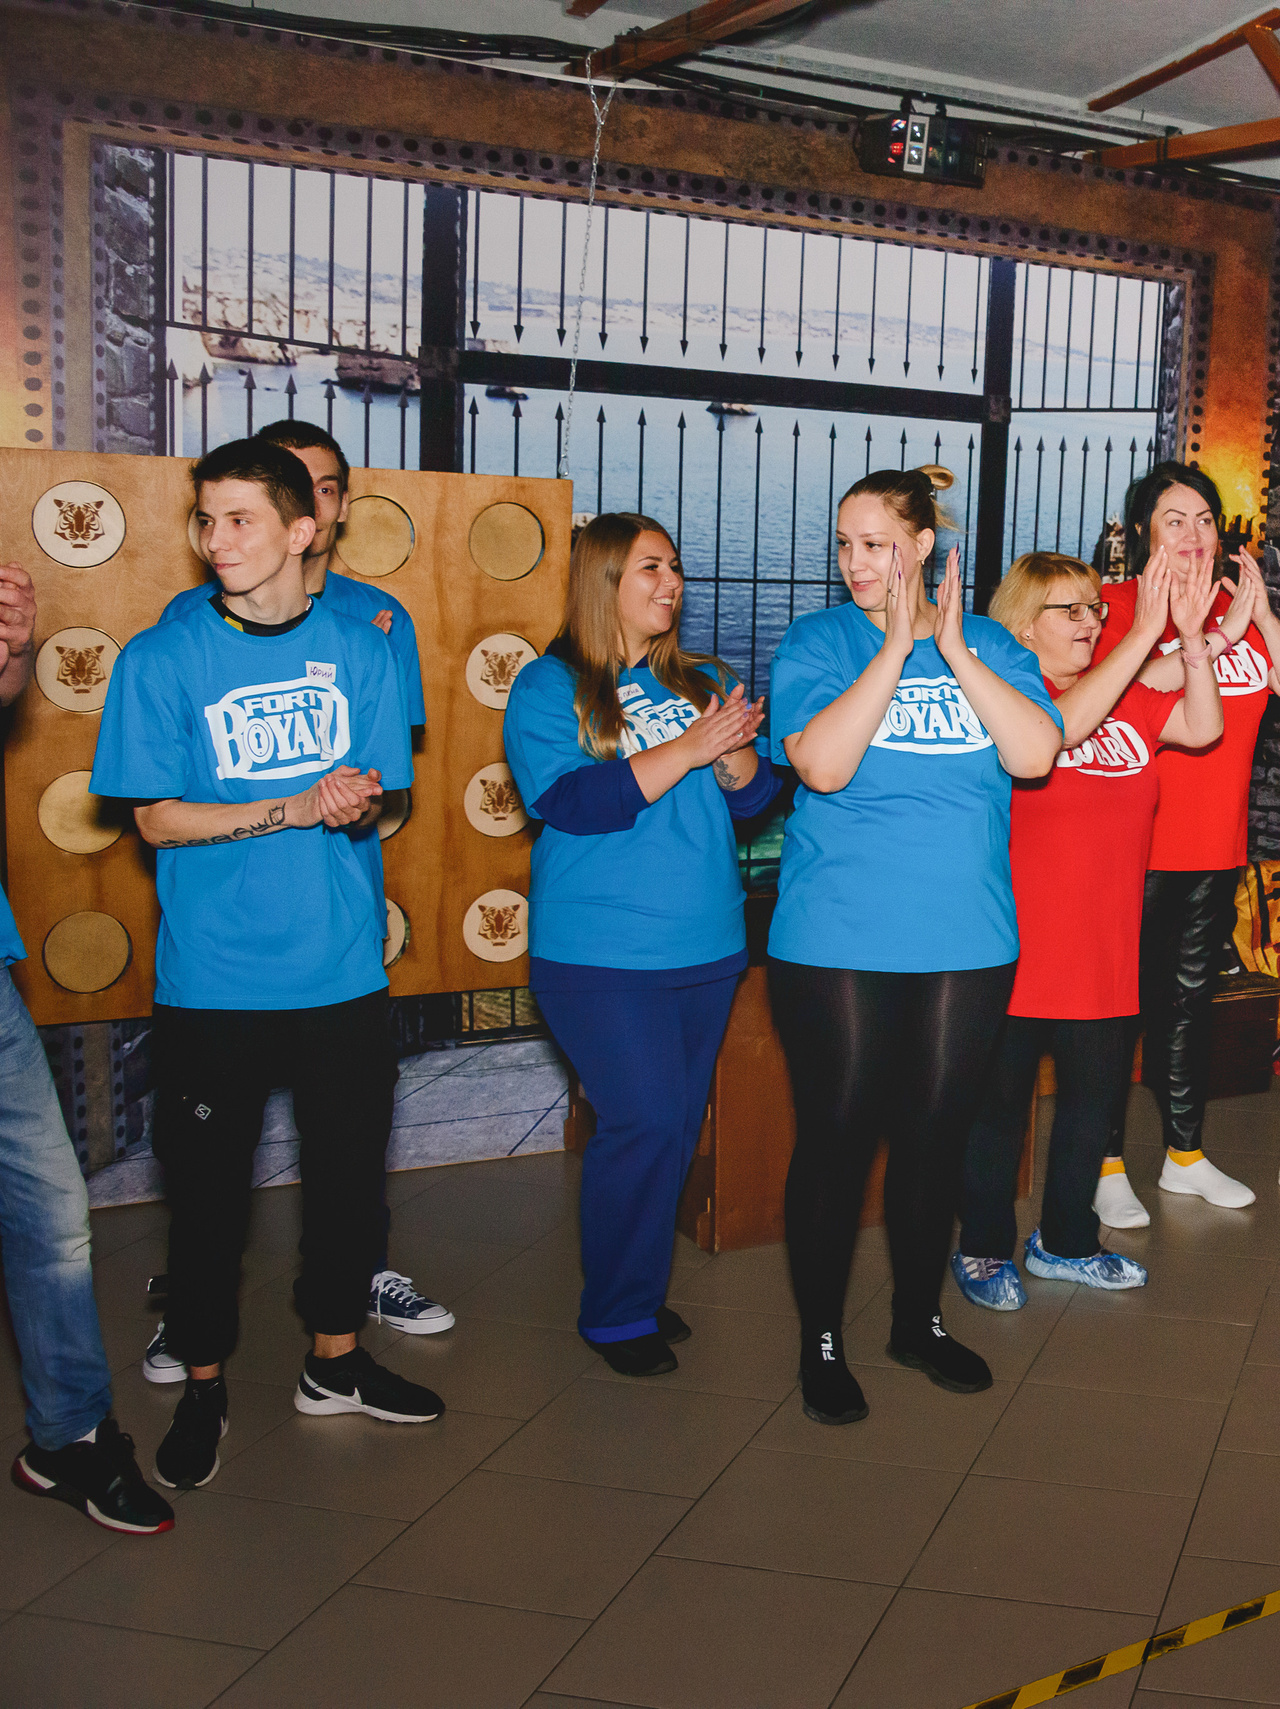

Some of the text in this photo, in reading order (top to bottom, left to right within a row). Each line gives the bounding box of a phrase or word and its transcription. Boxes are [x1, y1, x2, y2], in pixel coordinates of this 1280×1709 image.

[309, 665, 333, 679] Юрий
[244, 689, 317, 716] FORT
[204, 684, 351, 780] BOYARD
[821, 1332, 835, 1361] FILA
